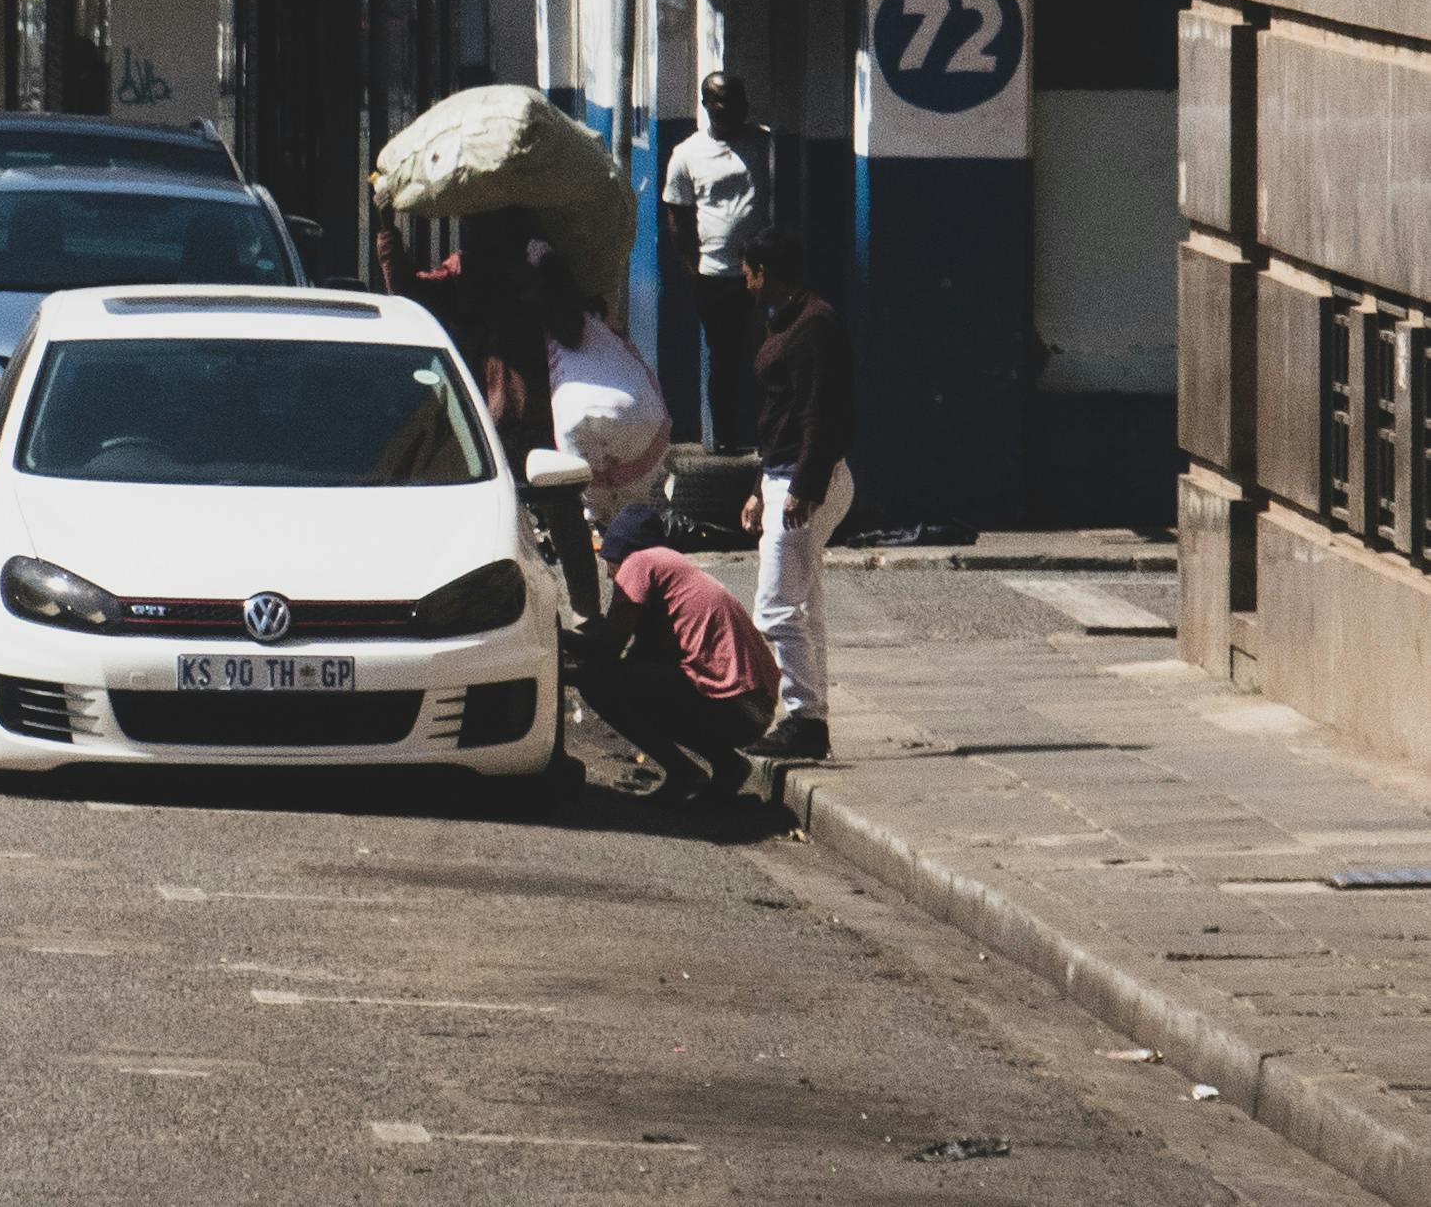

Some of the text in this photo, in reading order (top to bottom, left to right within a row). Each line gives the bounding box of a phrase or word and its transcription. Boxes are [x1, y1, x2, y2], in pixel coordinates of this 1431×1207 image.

[182, 658, 350, 687] KS 90 TH GP
